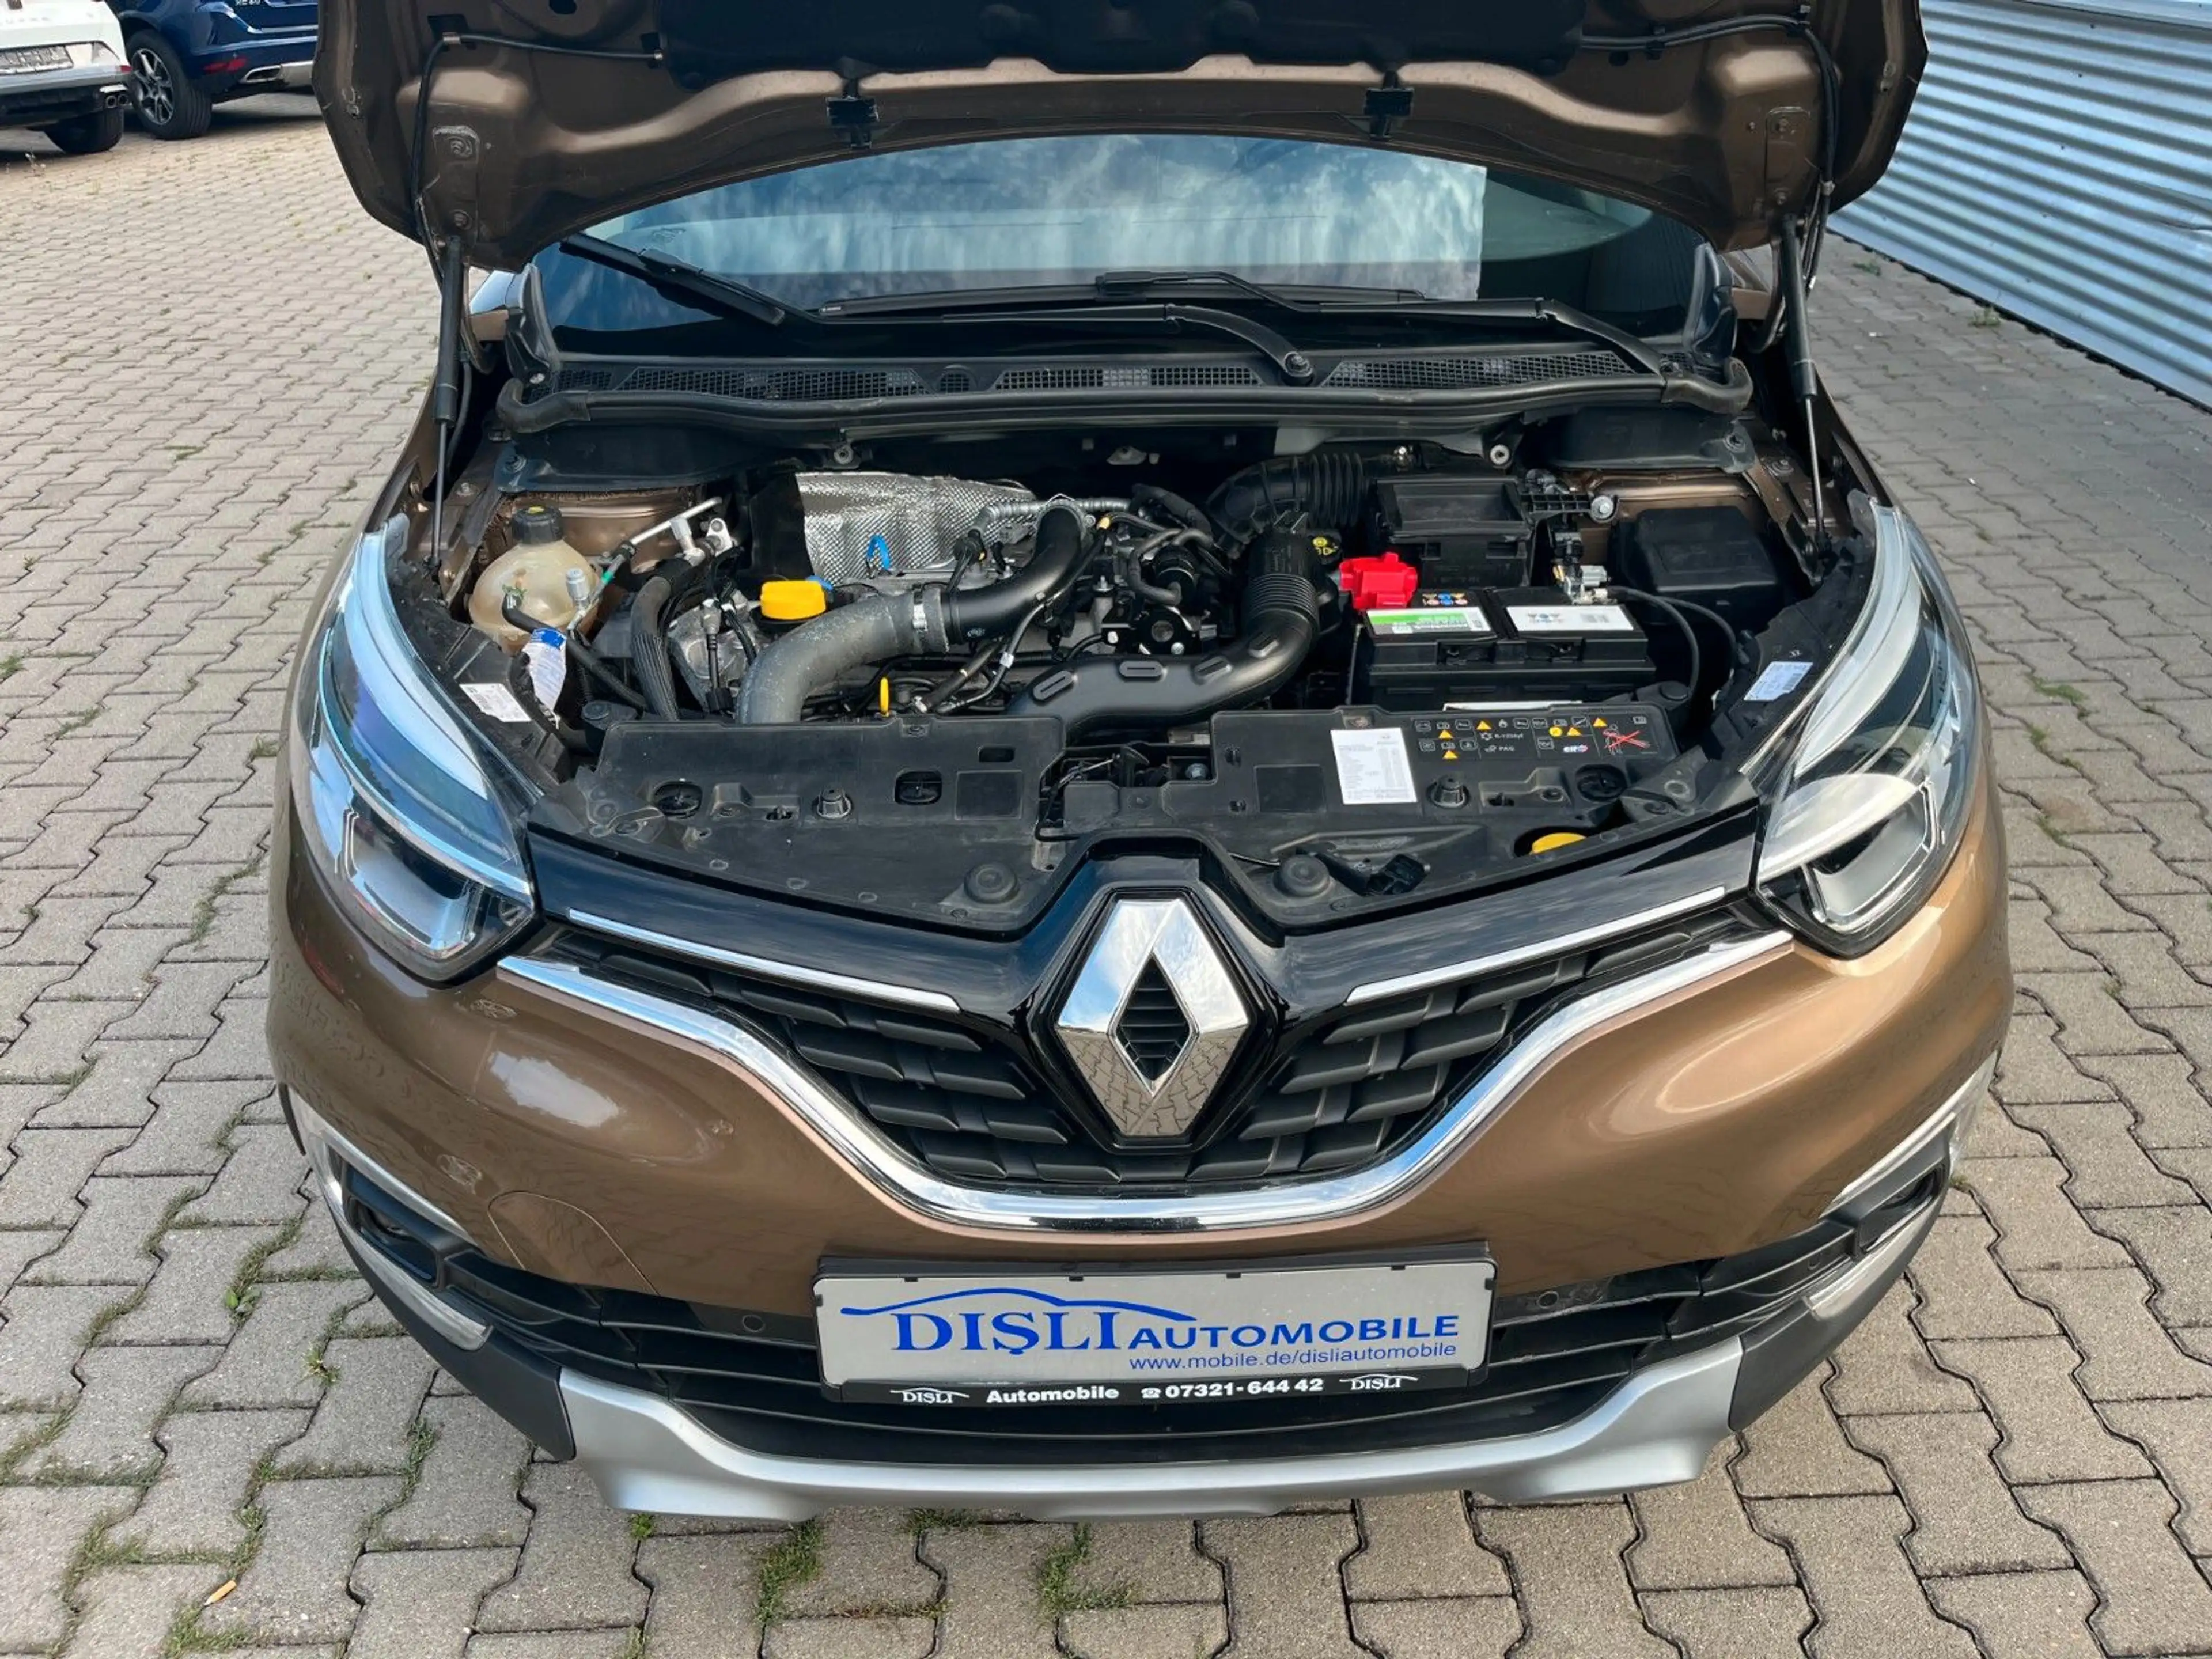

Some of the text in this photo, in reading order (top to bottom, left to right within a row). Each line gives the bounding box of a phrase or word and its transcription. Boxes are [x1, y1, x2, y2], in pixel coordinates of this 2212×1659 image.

[891, 1311, 1459, 1357] DIŞLI AUTOMOBILE
[1129, 1343, 1456, 1369] www.mobile.de/disliautomobile
[986, 1386, 1120, 1403] Automobile
